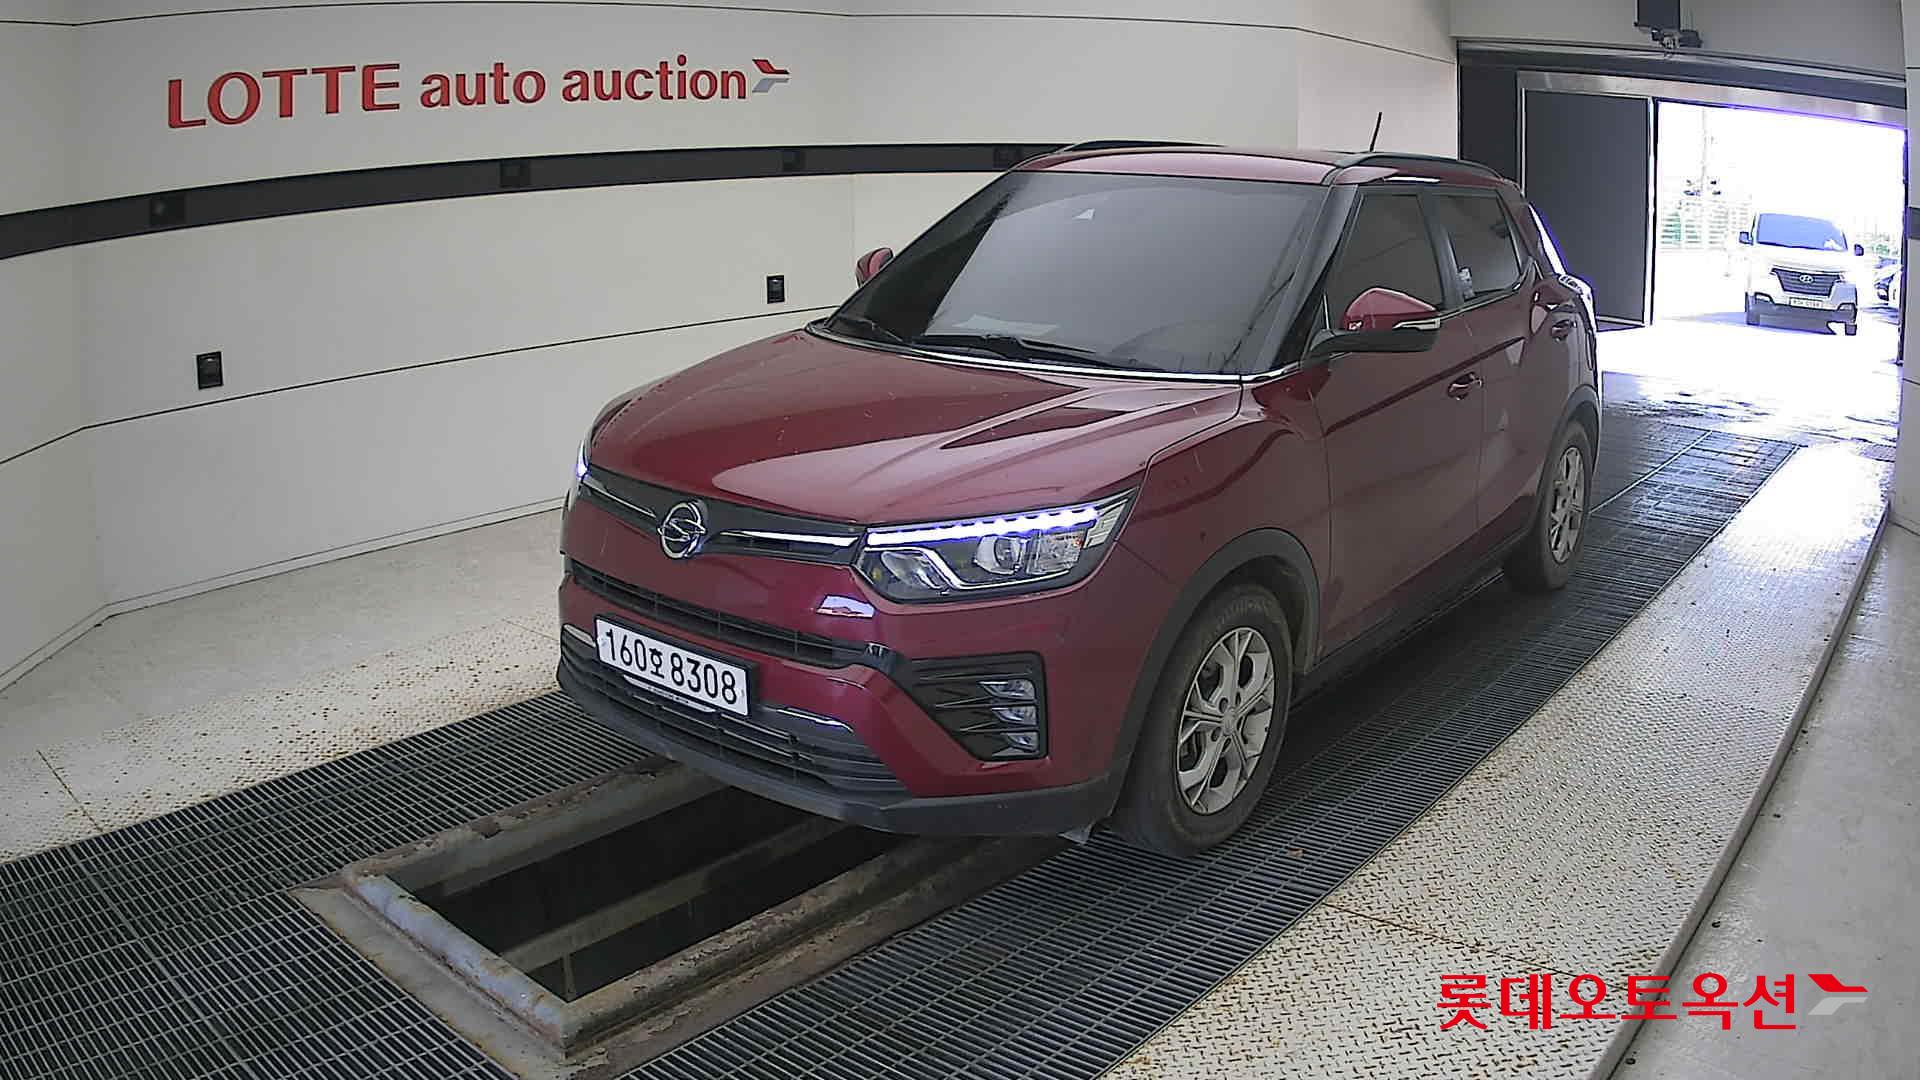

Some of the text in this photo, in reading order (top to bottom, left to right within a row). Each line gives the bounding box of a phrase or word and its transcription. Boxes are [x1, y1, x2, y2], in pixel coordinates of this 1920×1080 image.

[167, 54, 747, 129] LOTTE auto auction
